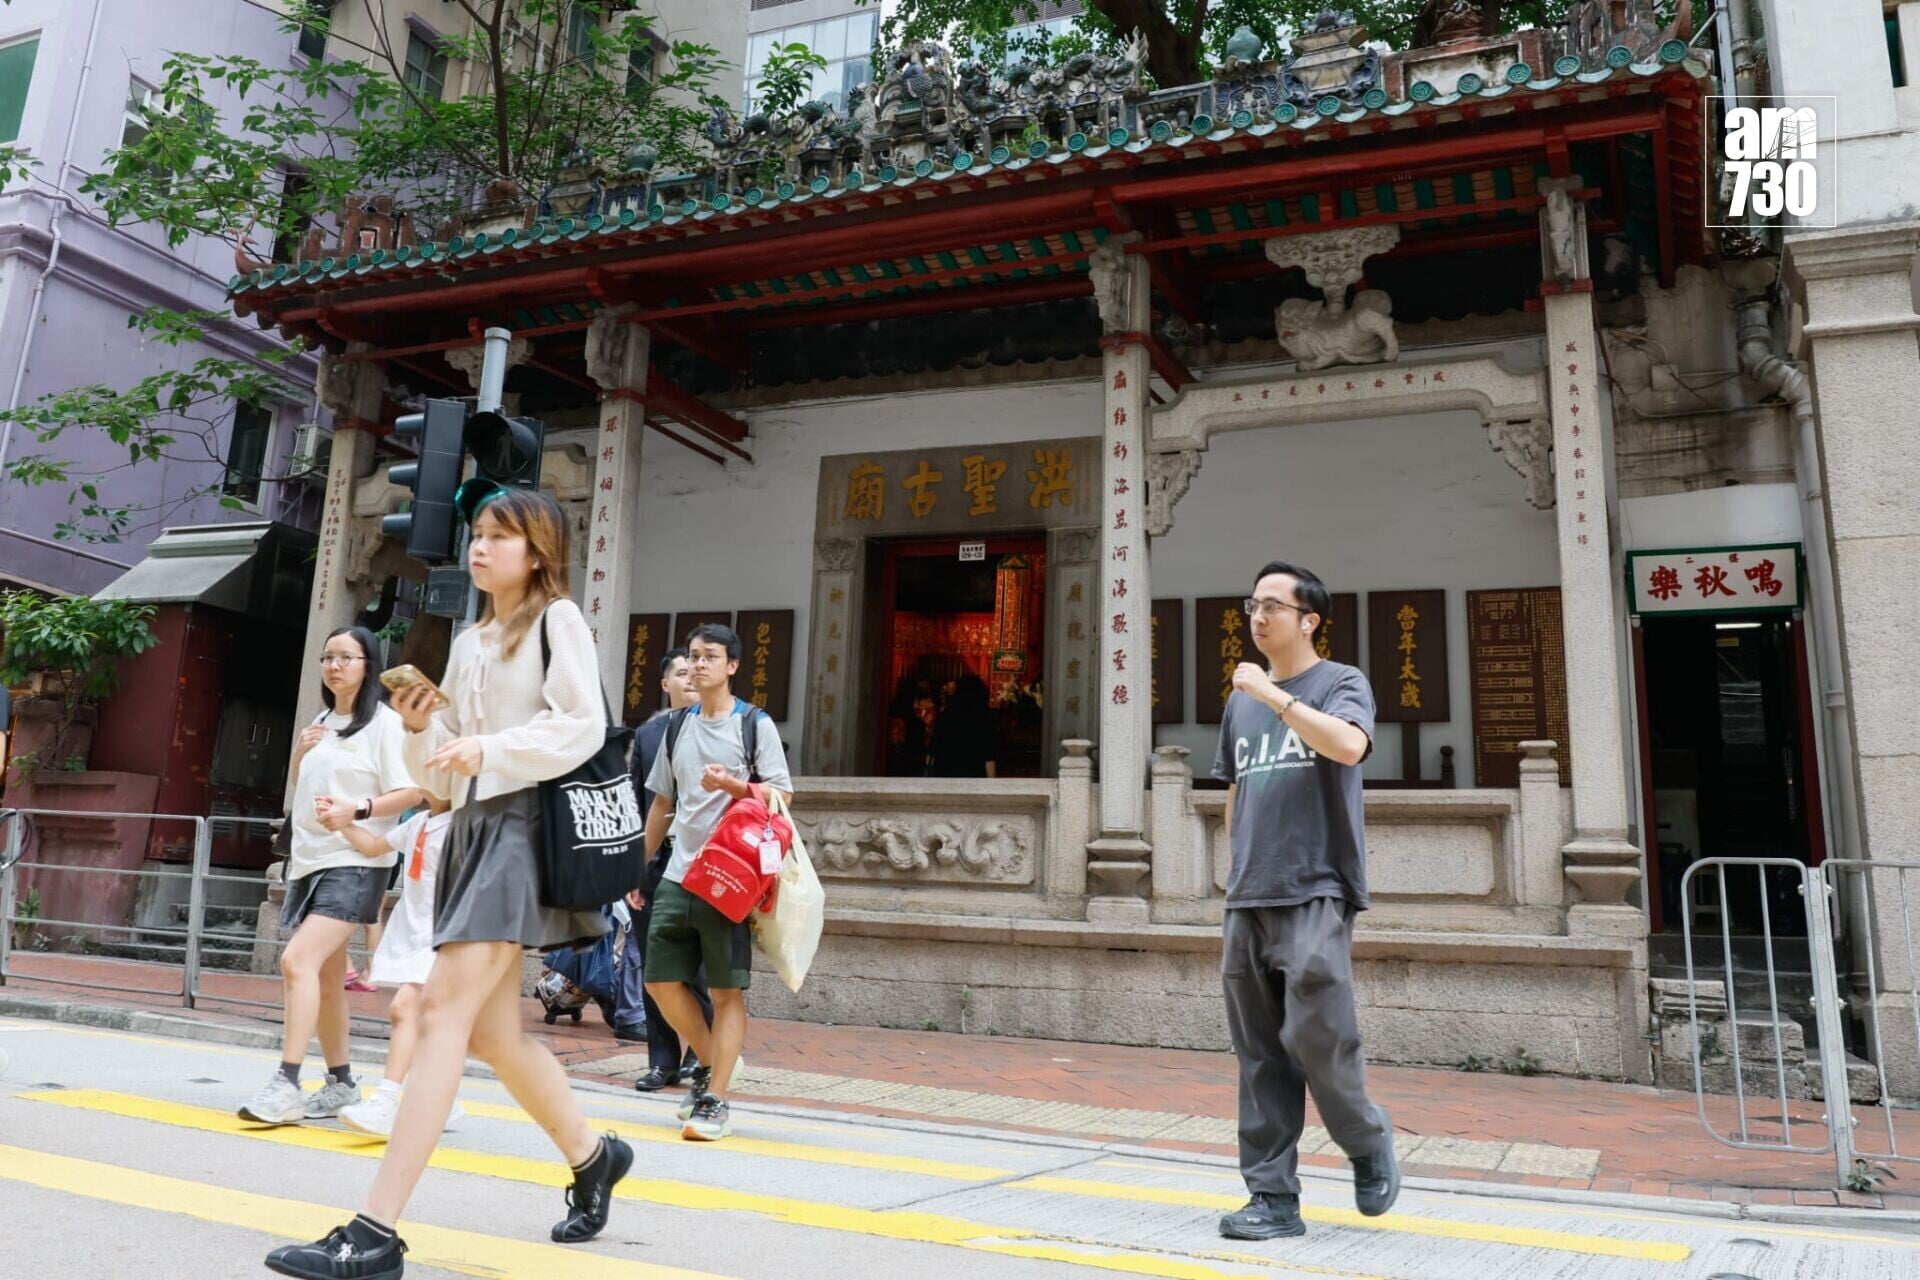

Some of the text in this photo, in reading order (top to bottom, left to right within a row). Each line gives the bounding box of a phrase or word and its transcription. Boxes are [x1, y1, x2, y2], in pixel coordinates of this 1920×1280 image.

[626, 623, 649, 709] 華光大帝
[1396, 604, 1421, 708] 當年太歲
[1235, 727, 1316, 770] C.I.A.
